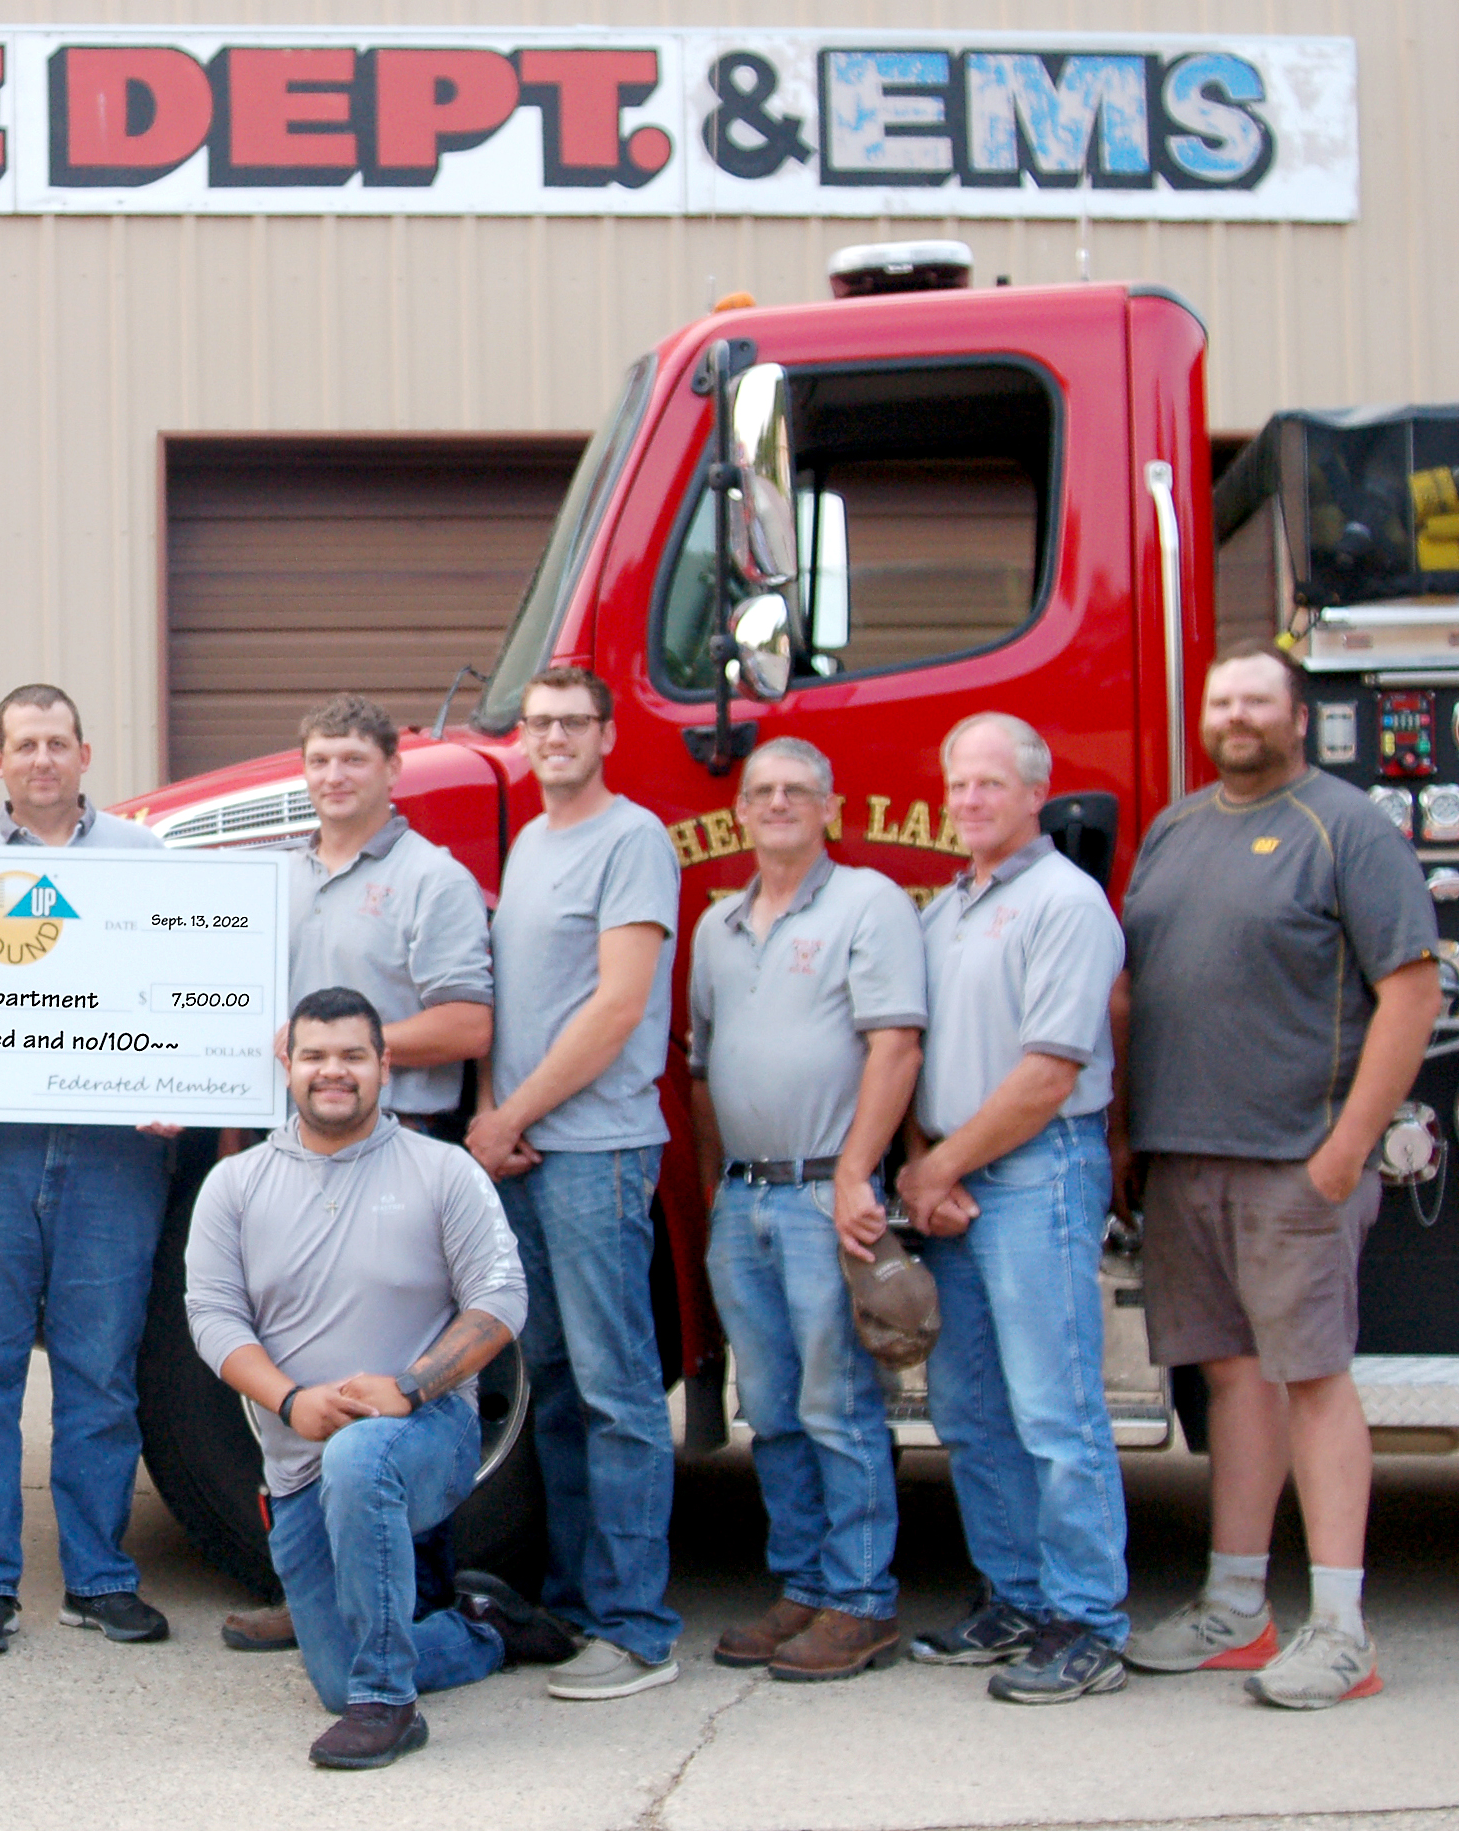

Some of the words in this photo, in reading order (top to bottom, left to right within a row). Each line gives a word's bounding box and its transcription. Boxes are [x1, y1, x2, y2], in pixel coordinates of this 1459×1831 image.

[48, 47, 672, 189] DEPT.
[701, 50, 818, 180] &
[817, 50, 1276, 190] EMS
[31, 887, 57, 917] UP
[105, 920, 137, 931] DATE
[151, 914, 187, 930] Sept.
[191, 915, 209, 929] 13,
[212, 915, 249, 928] 2022
[172, 992, 250, 1008] 7,500.00
[23, 1030, 63, 1049] and
[205, 1047, 262, 1058] DOLLARS
[47, 1075, 150, 1092] Federated
[156, 1076, 251, 1096] Members
